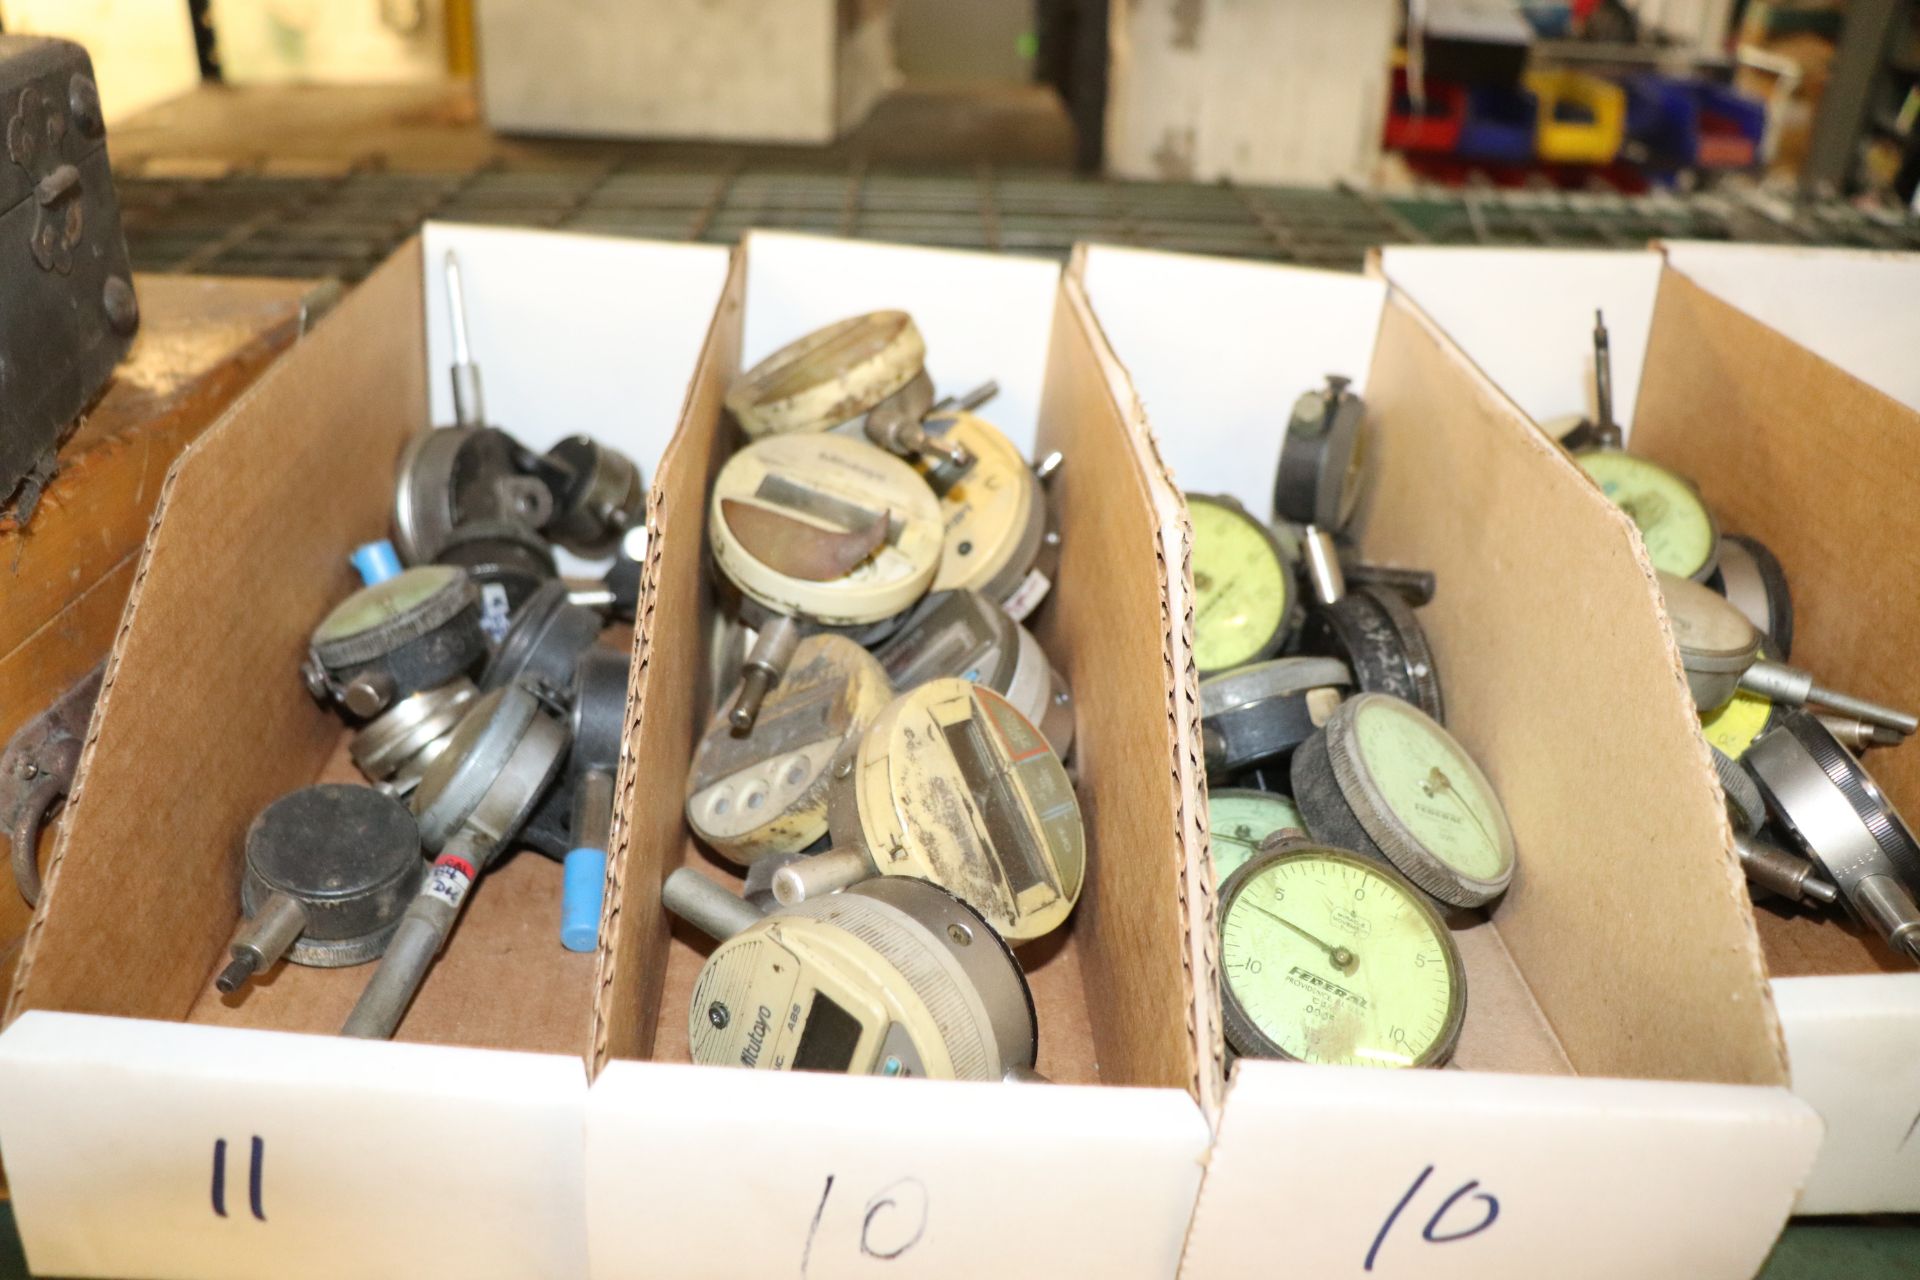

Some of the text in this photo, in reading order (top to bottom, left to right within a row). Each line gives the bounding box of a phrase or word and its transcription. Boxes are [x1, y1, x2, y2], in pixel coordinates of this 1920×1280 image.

[1273, 887, 1286, 902] 5
[1354, 887, 1366, 902] 0
[1244, 956, 1263, 975] 10
[1414, 952, 1426, 969] 5
[1288, 965, 1368, 1010] FEDERAL
[787, 1002, 801, 1034] ABS
[1389, 1025, 1406, 1044] 10
[211, 1134, 268, 1222] 11
[800, 1174, 929, 1280] 10
[1363, 1164, 1500, 1272] 10
